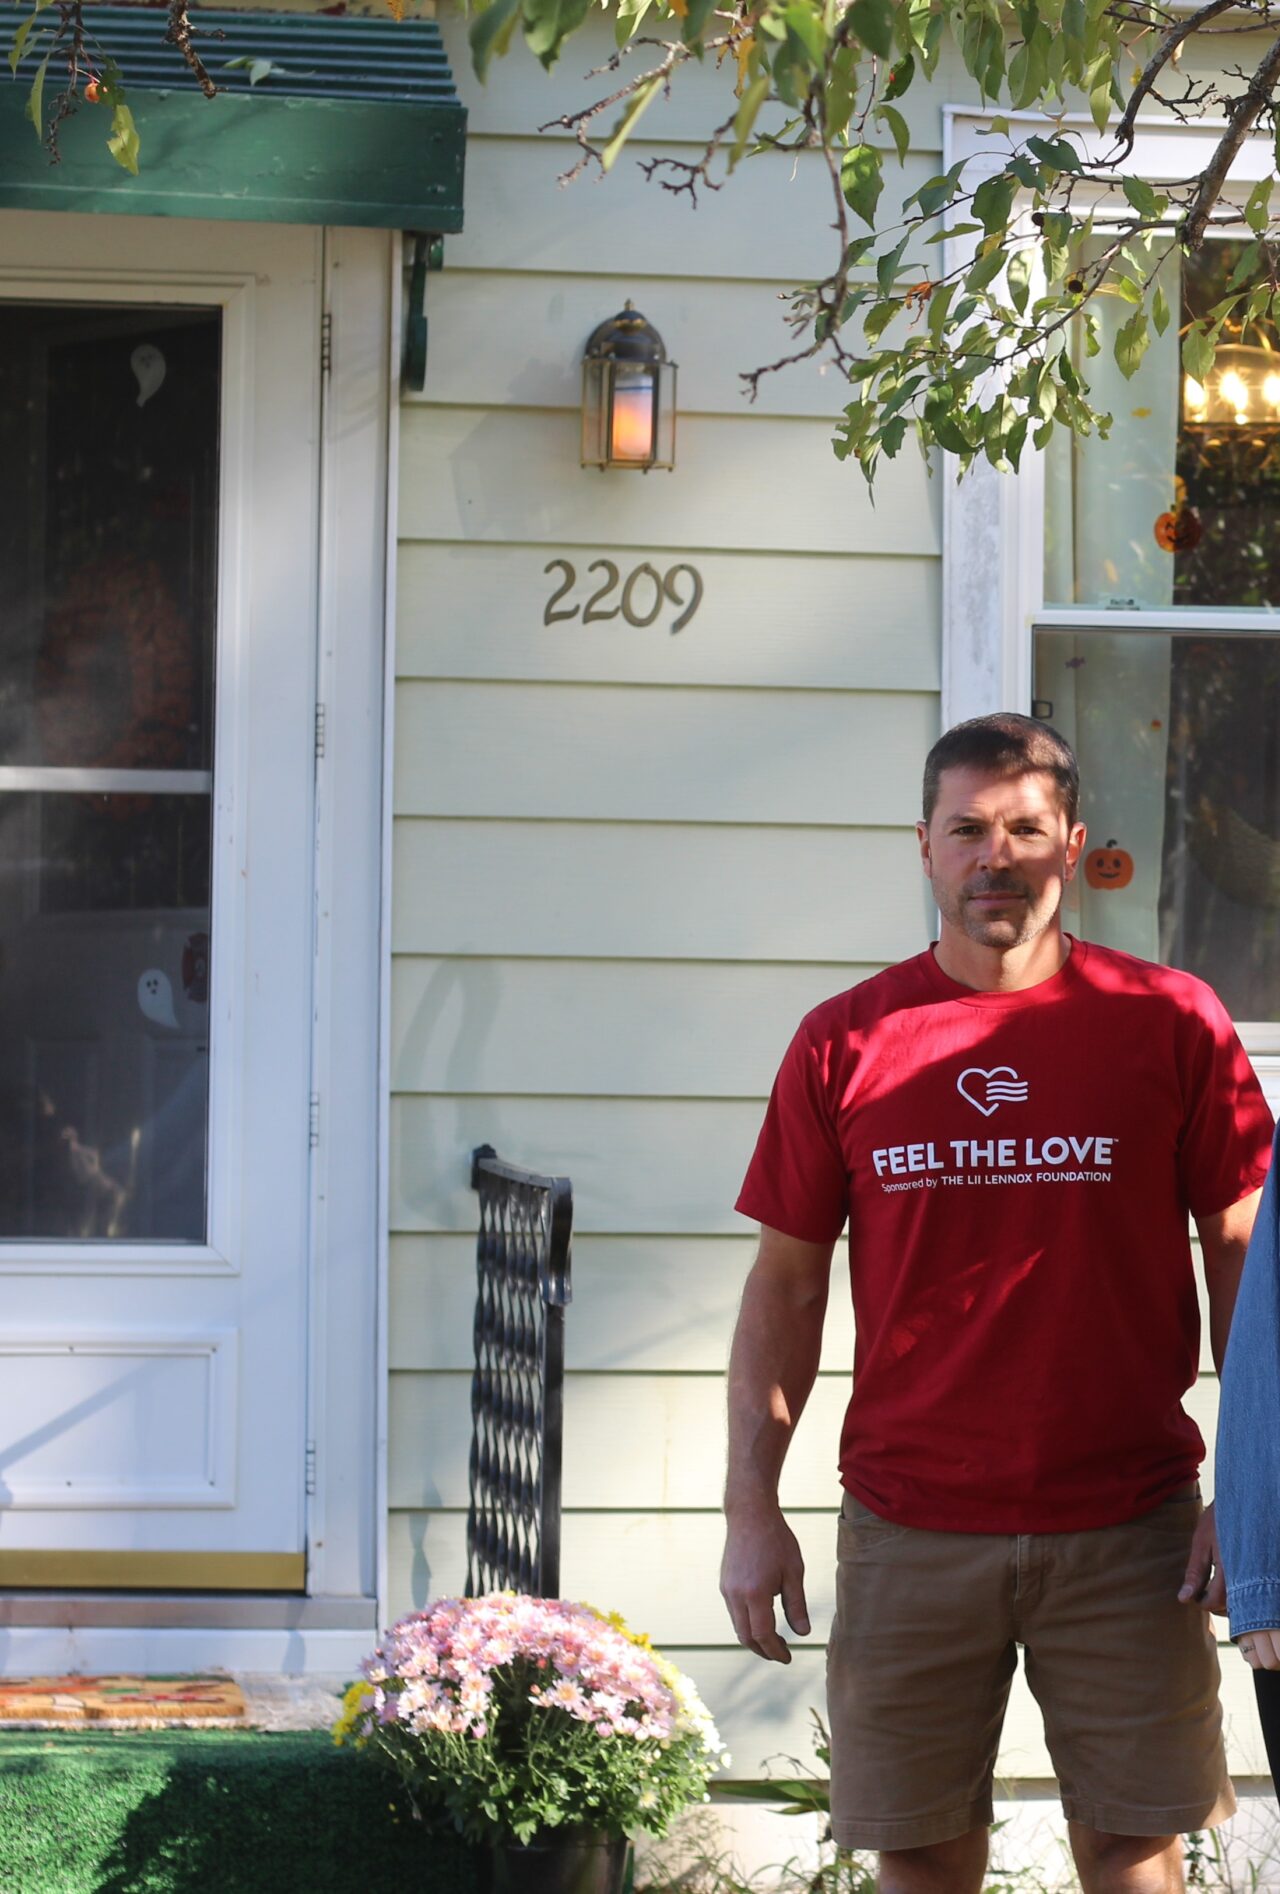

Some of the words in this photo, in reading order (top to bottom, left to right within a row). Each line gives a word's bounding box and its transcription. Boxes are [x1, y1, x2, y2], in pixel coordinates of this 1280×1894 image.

[543, 558, 704, 636] 2209
[872, 1142, 944, 1177] FEEL
[949, 1139, 1017, 1168] THE
[881, 1177, 924, 1194] Sponsored
[925, 1176, 938, 1189] by
[941, 1175, 964, 1186] THE
[985, 1173, 1033, 1185] LENNOX
[1036, 1171, 1112, 1183] FOUNDATION
